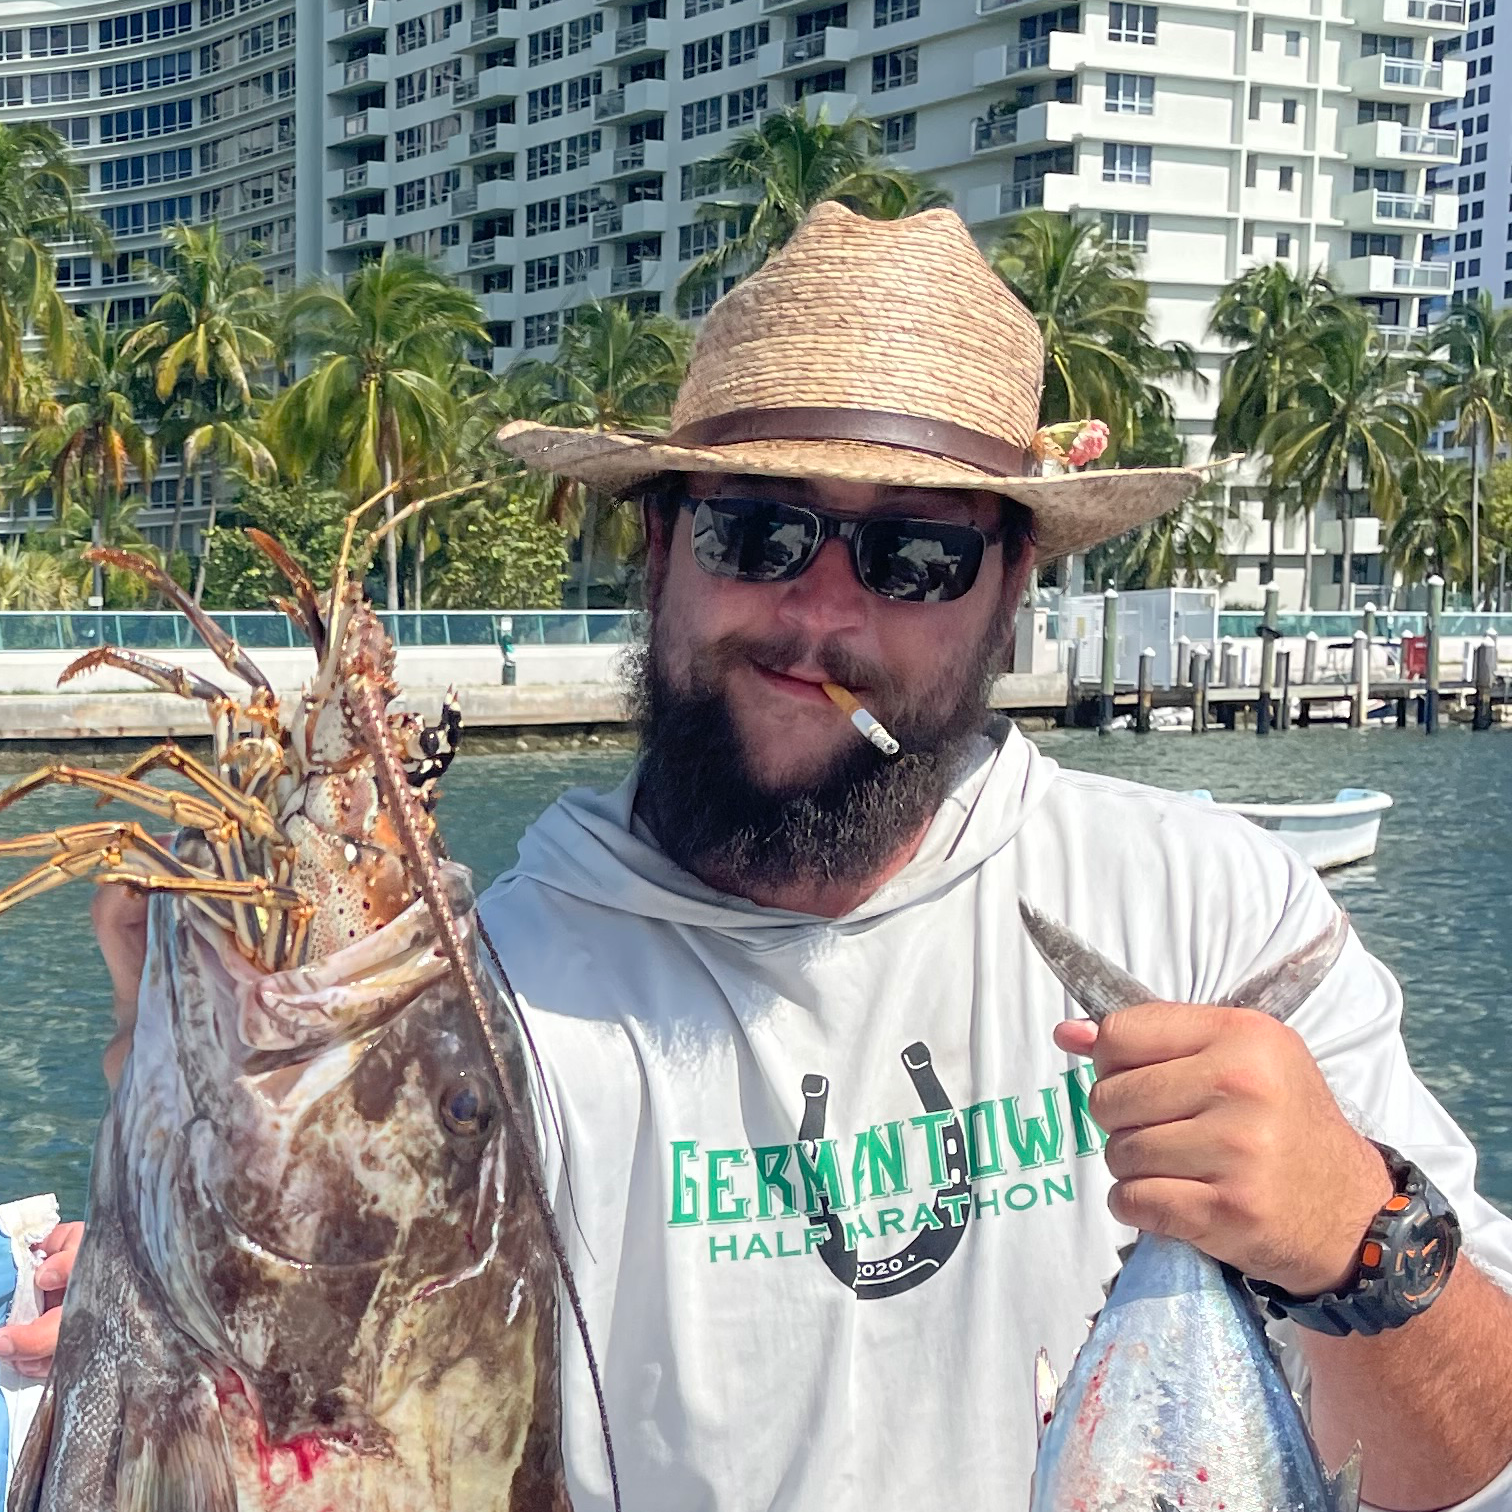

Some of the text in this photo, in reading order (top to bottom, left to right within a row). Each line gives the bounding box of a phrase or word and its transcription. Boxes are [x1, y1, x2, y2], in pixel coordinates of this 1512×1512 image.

[667, 1063, 1106, 1228] GERMANTOWN
[709, 1173, 1075, 1263] HALF MARATHON
